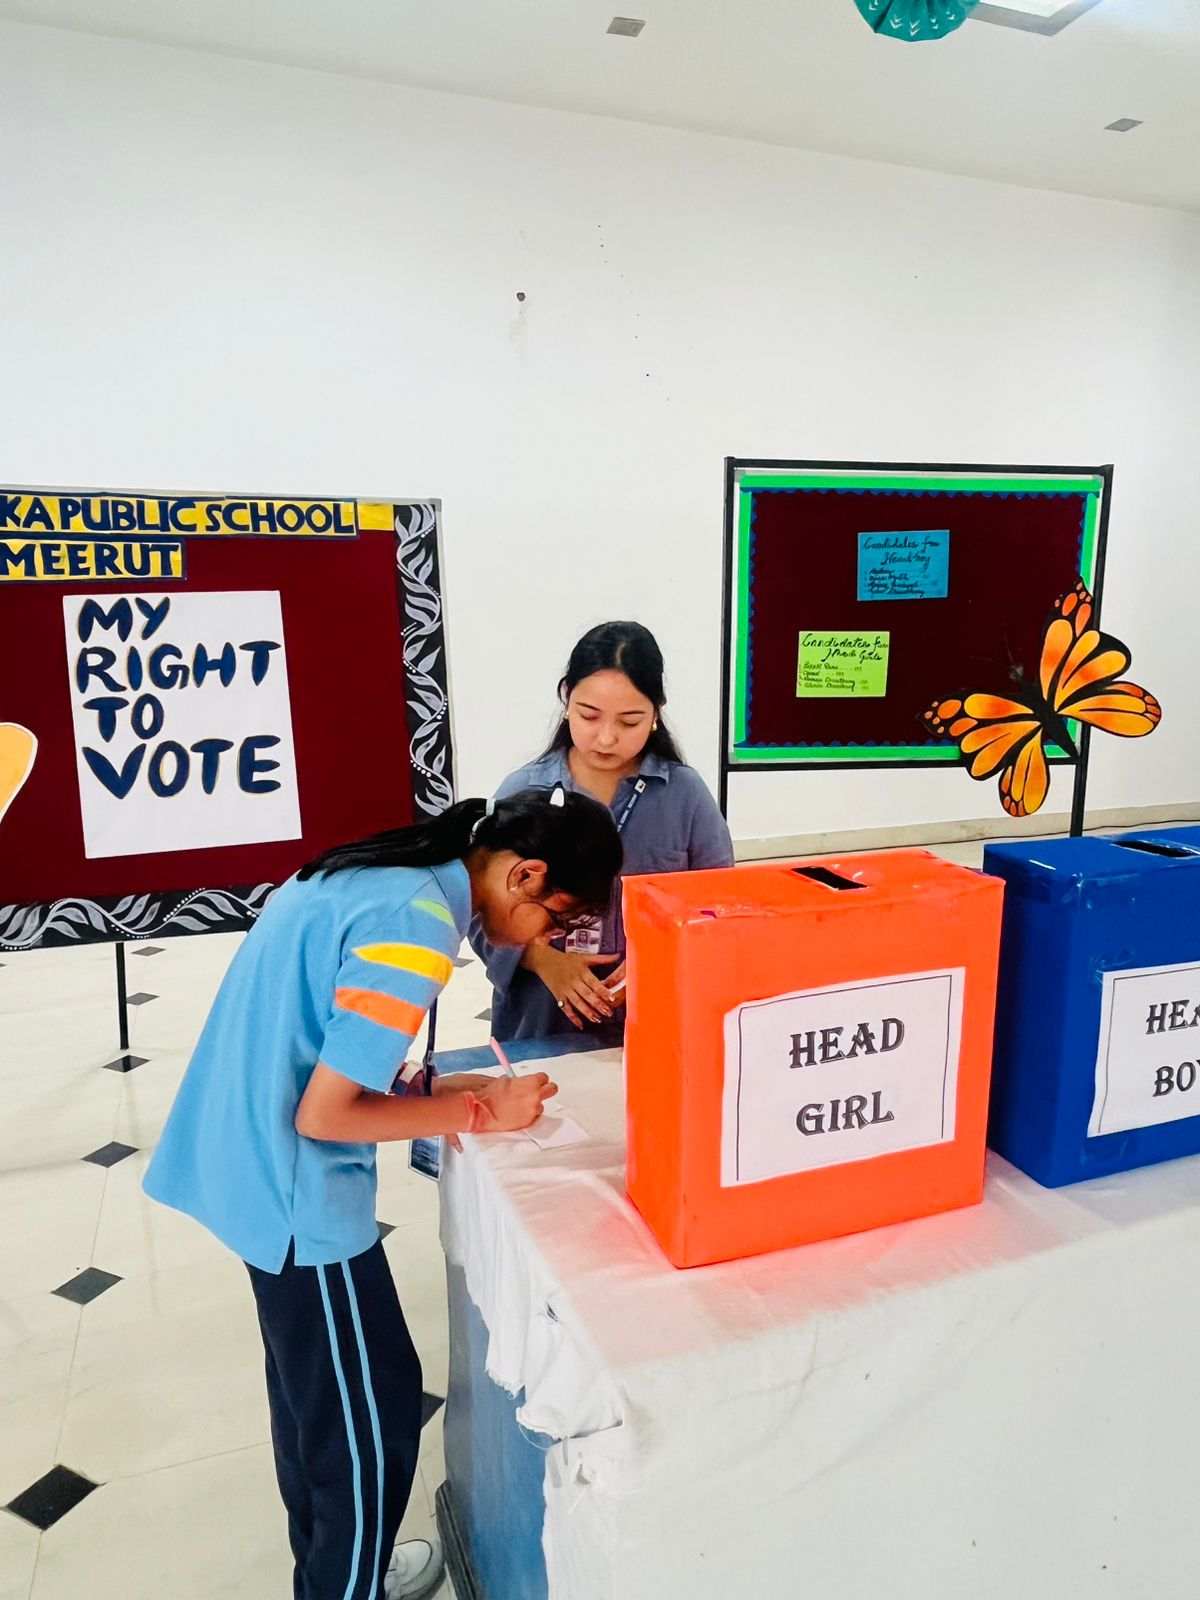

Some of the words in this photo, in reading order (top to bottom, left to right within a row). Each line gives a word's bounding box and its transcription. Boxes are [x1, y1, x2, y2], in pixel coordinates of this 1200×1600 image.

[58, 497, 197, 532] PUBLIC
[205, 501, 356, 534] SCHOOL
[0, 542, 180, 577] MEERUT
[77, 596, 171, 643] MY
[76, 640, 282, 694] RIGHT
[82, 693, 165, 744] TO
[81, 734, 282, 800] VOTE
[788, 1017, 906, 1069] HEAD
[1152, 1059, 1200, 1098] BO
[796, 1090, 895, 1136] GIRL
